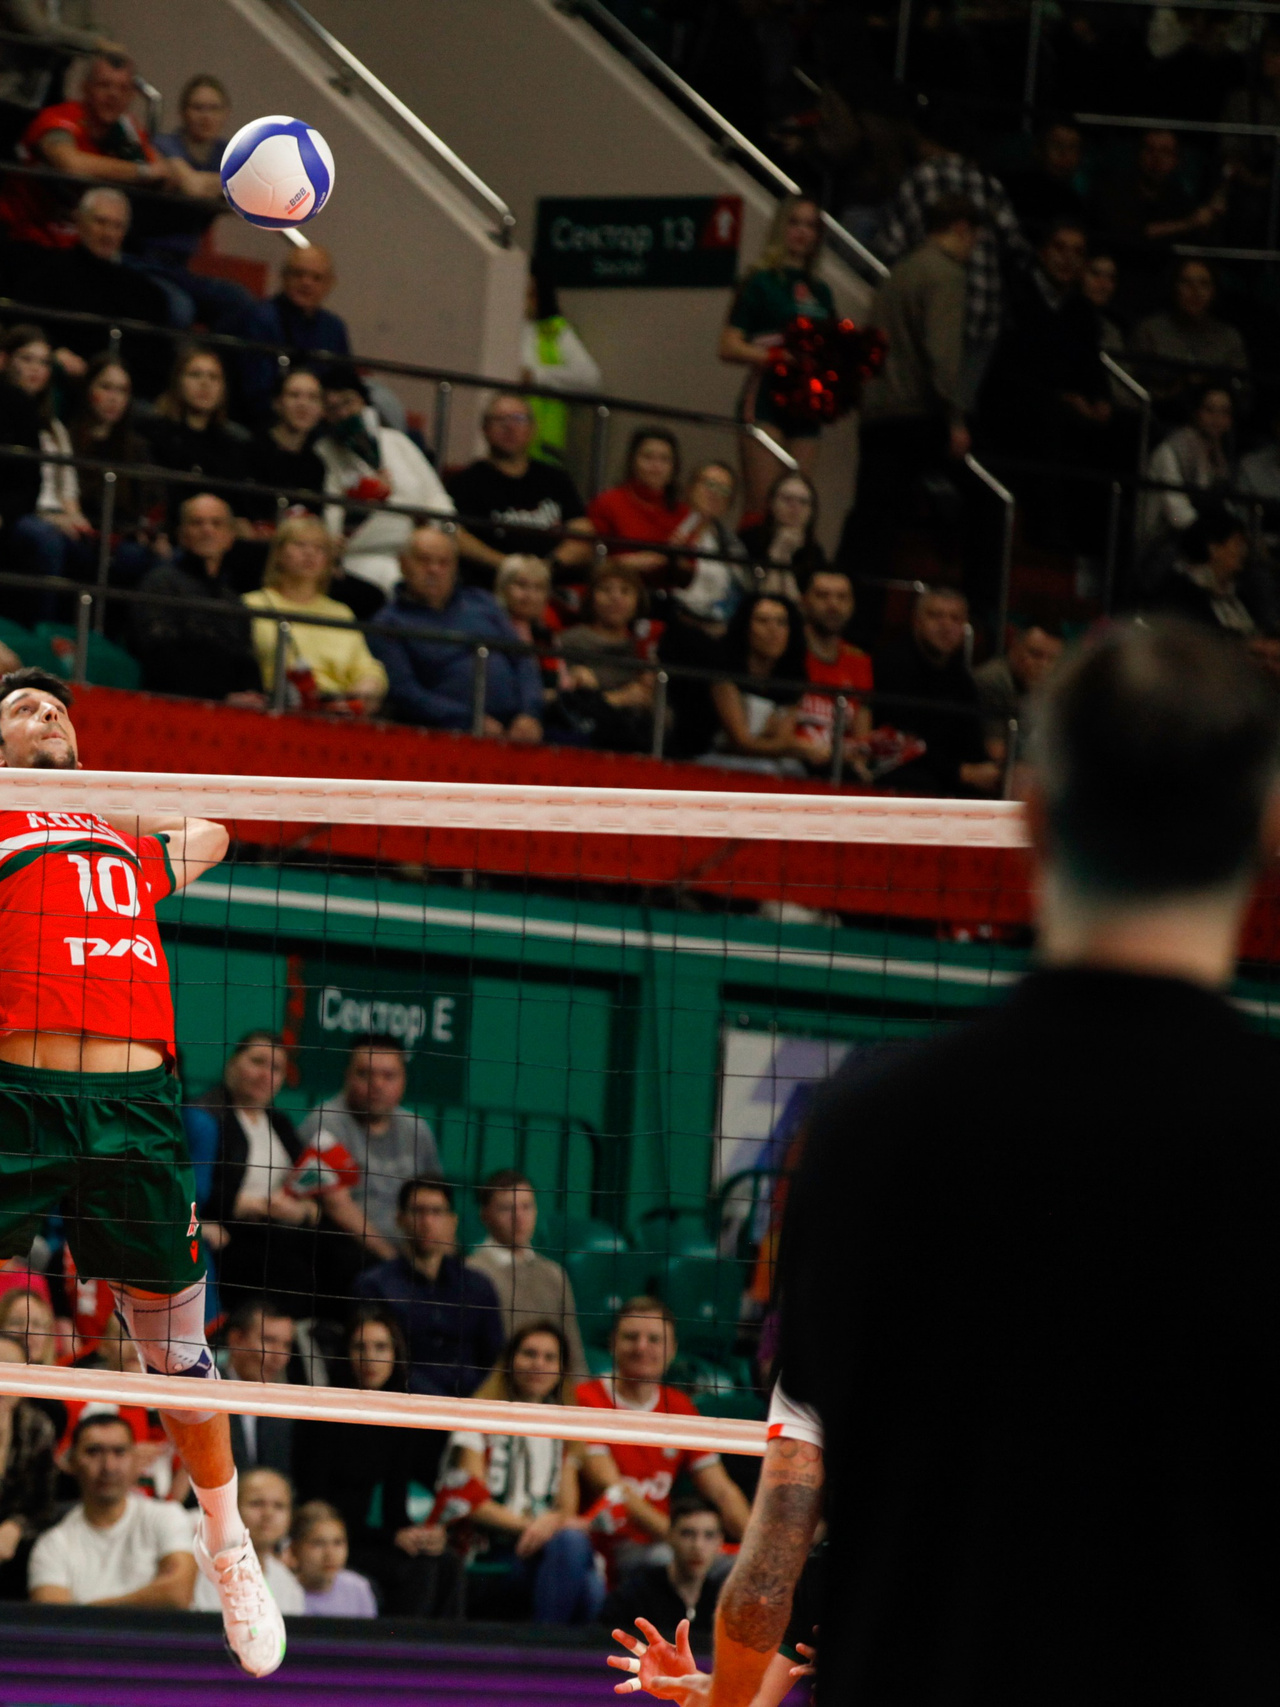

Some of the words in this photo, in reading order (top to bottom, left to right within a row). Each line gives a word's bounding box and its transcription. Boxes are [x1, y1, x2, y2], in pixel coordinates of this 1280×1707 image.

[289, 187, 307, 207] ВФВ
[550, 216, 654, 256] Сектор
[661, 215, 696, 251] 13
[67, 853, 141, 918] 10
[318, 986, 426, 1049] Сектор
